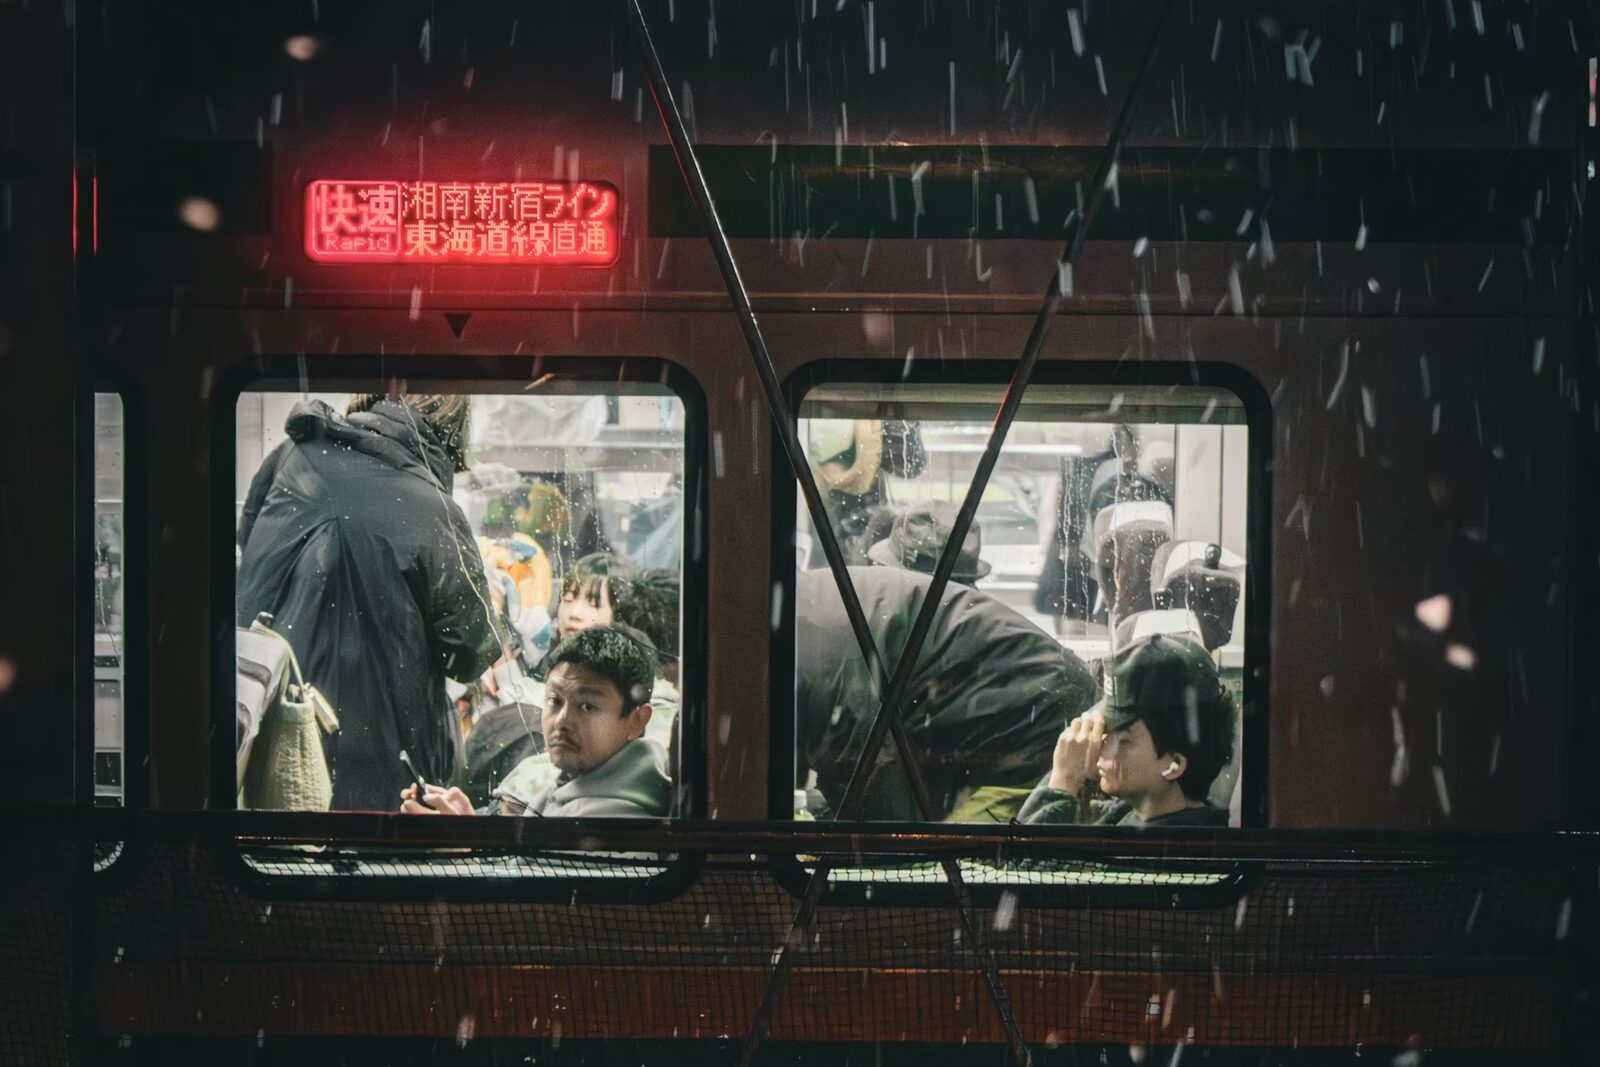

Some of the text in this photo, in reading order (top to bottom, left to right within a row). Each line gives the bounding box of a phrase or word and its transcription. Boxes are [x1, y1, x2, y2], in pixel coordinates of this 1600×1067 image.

[316, 184, 397, 233] 快速
[402, 182, 609, 220] 湘南新宿ライン
[325, 233, 391, 251] Rapid
[404, 221, 607, 256] 東海道線直通
